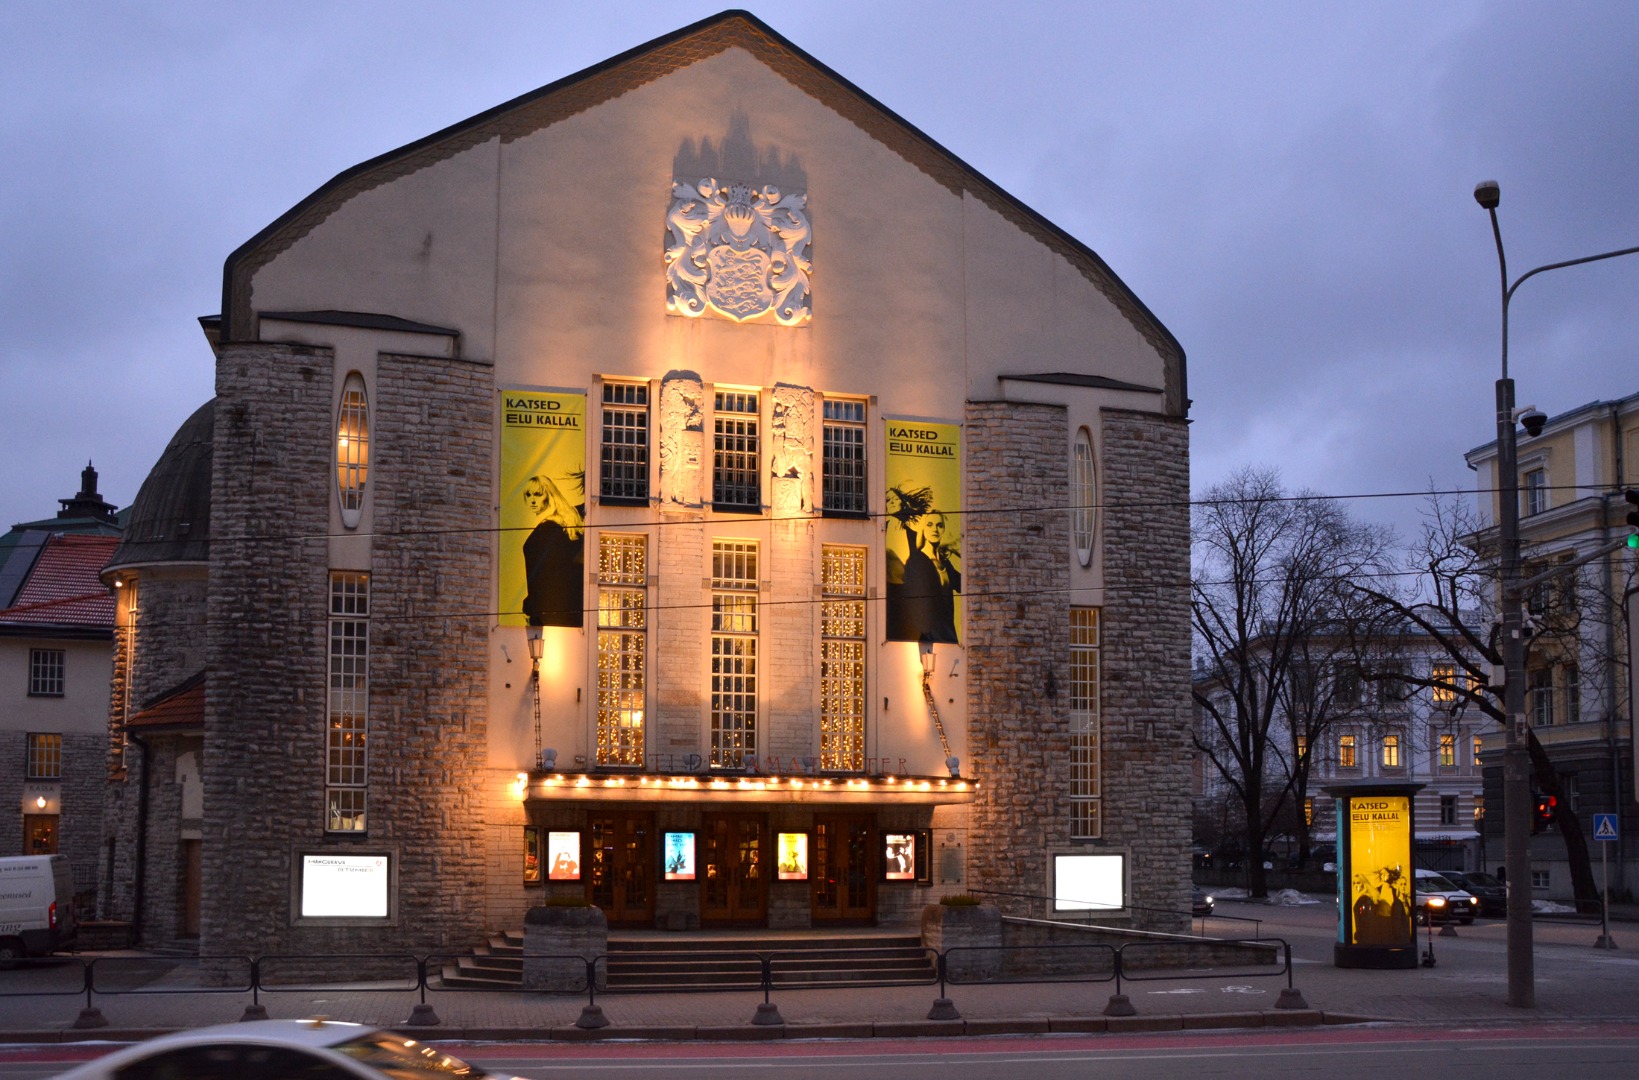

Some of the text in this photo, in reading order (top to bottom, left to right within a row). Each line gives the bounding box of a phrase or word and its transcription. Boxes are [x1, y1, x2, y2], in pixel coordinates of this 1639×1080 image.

[506, 398, 561, 411] KATSED
[506, 413, 578, 427] ELU KALLAL
[889, 427, 938, 440] KATSED
[889, 442, 954, 456] ELU KALLAL
[1352, 802, 1389, 811] KATSED
[1352, 812, 1399, 821] ELU KALLAL
